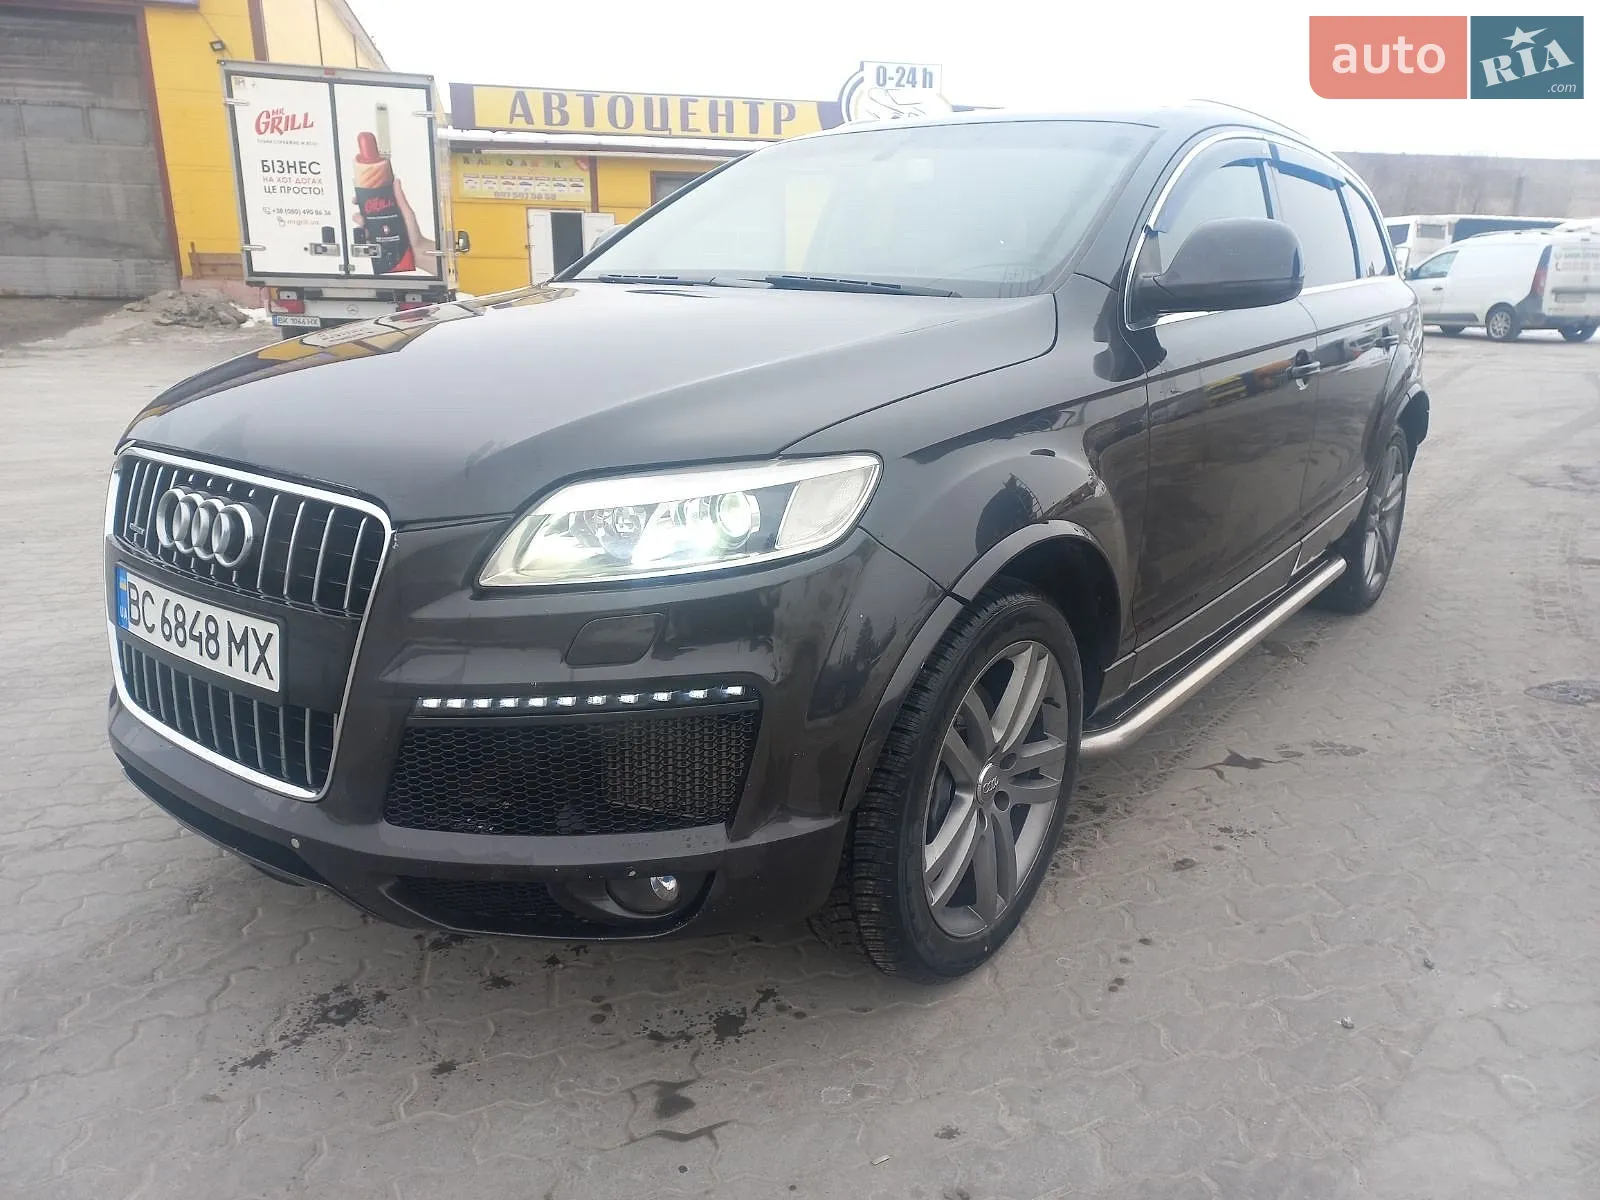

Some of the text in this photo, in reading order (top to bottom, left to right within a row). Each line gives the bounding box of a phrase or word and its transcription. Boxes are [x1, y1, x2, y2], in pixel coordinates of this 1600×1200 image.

[876, 65, 933, 88] 0-24 h
[255, 110, 314, 135] GRILL
[508, 90, 797, 136] АВТОЦЕНТР
[261, 159, 321, 175] БІЗНЕС
[264, 185, 324, 195] ЦЕ ПРОСТО!
[127, 581, 275, 681] BC 6848 MX
